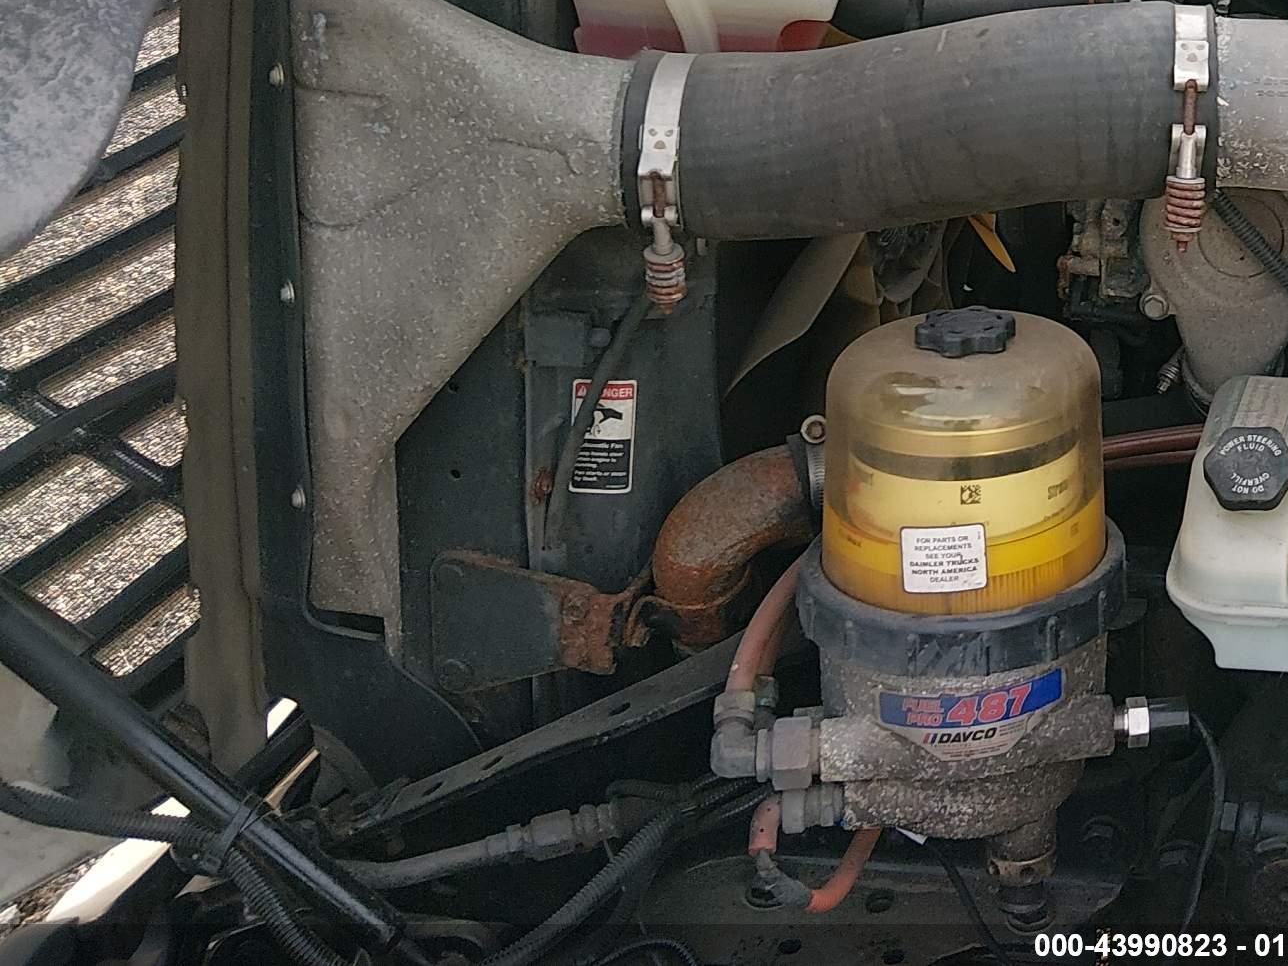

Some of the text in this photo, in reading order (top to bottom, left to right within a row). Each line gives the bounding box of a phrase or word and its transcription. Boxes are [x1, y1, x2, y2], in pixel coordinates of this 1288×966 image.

[1220, 434, 1282, 456] POWER STEERING
[1237, 443, 1265, 452] FLUID
[1230, 472, 1270, 486] OVERFILL
[1232, 485, 1264, 494] DO NOT
[914, 543, 972, 552] REPLACEMENTS
[946, 558, 979, 566] TRUCKS
[941, 566, 977, 575] AMERICA
[929, 575, 959, 583] DEALER
[903, 682, 1032, 726] FUEL 487
[907, 712, 943, 726] PRO
[938, 727, 998, 744] DAVCO
